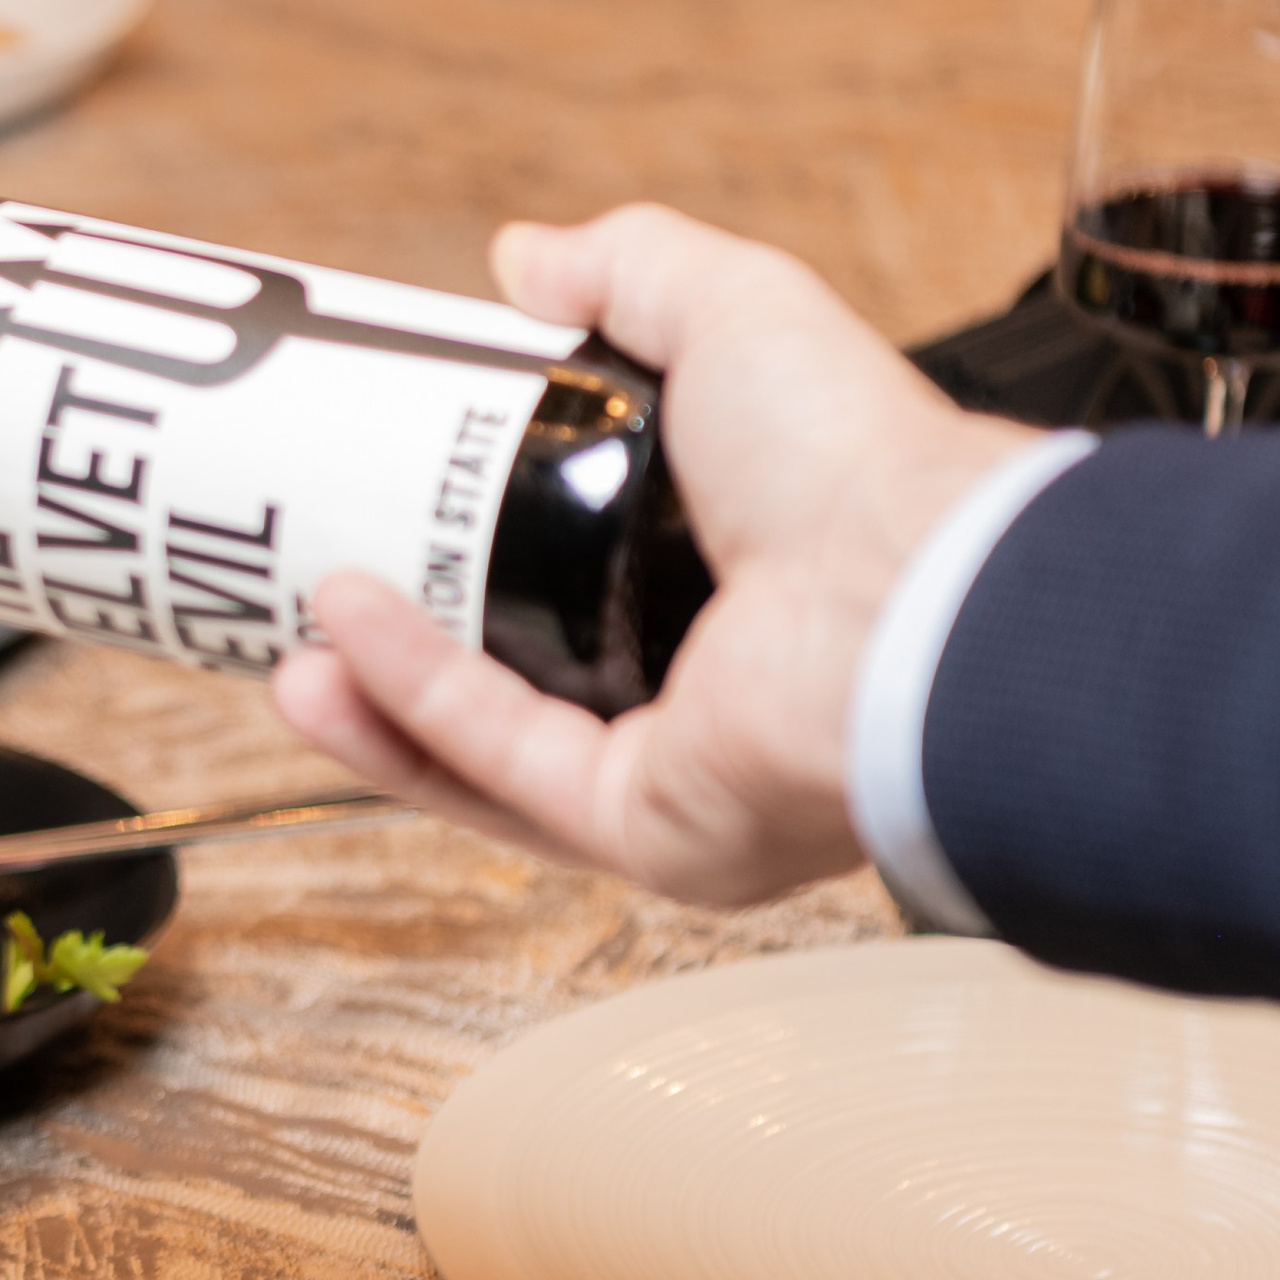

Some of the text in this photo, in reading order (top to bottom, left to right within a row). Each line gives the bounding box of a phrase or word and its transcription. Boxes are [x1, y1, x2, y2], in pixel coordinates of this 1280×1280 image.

[36, 364, 161, 650] ELVET
[434, 409, 508, 532] STATE
[166, 504, 283, 670] EVIL
